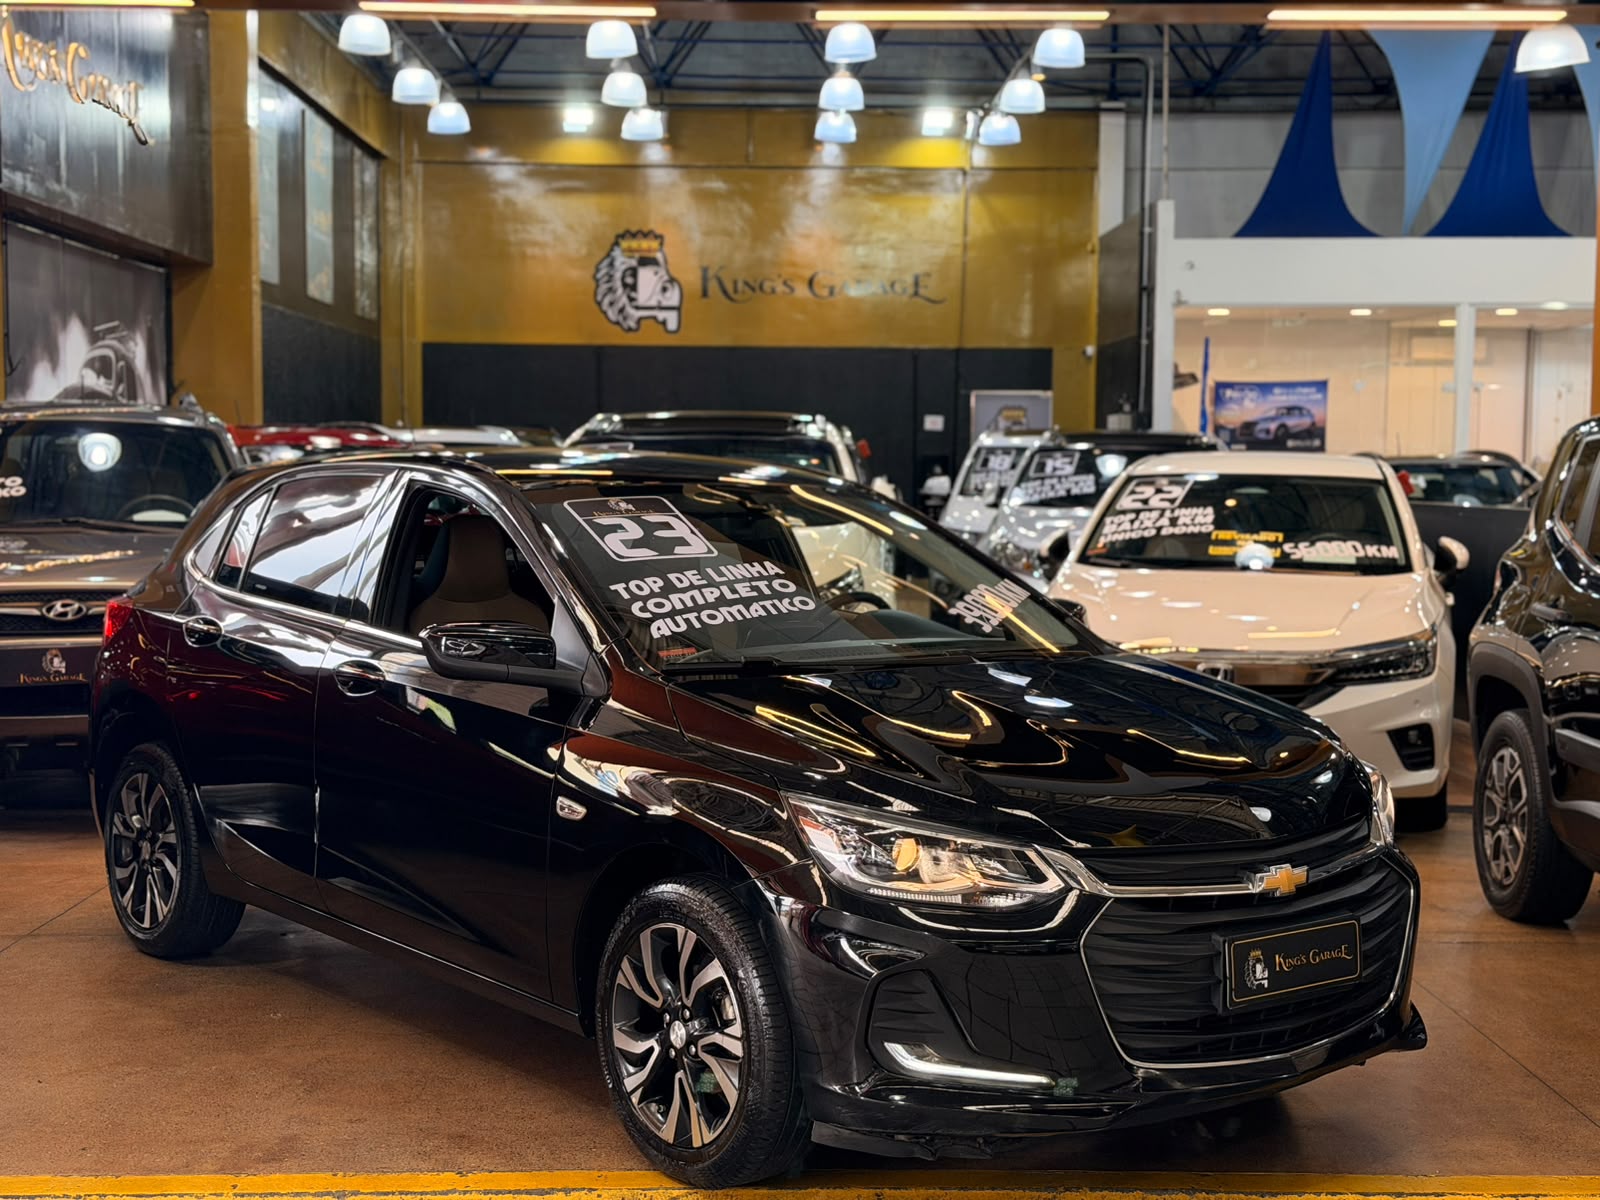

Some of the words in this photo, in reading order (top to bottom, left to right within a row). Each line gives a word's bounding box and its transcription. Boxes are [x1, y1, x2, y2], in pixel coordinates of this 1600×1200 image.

[1044, 458, 1074, 476] 15
[1125, 485, 1185, 509] 22
[1102, 517, 1170, 535] BAIXA
[1177, 514, 1215, 526] KM
[1104, 512, 1137, 526] TOP
[1138, 509, 1161, 521] DE
[1163, 505, 1215, 518] LINHA
[592, 515, 709, 558] 23
[1160, 523, 1215, 536] DONO
[609, 576, 665, 600] TOP
[666, 569, 708, 589] DE
[704, 560, 786, 584] LINHA
[630, 578, 797, 618] COMPLETO
[650, 596, 816, 640] AUTOMATICO
[1275, 953, 1307, 972] KING'S
[1309, 944, 1353, 965] GARAGE
